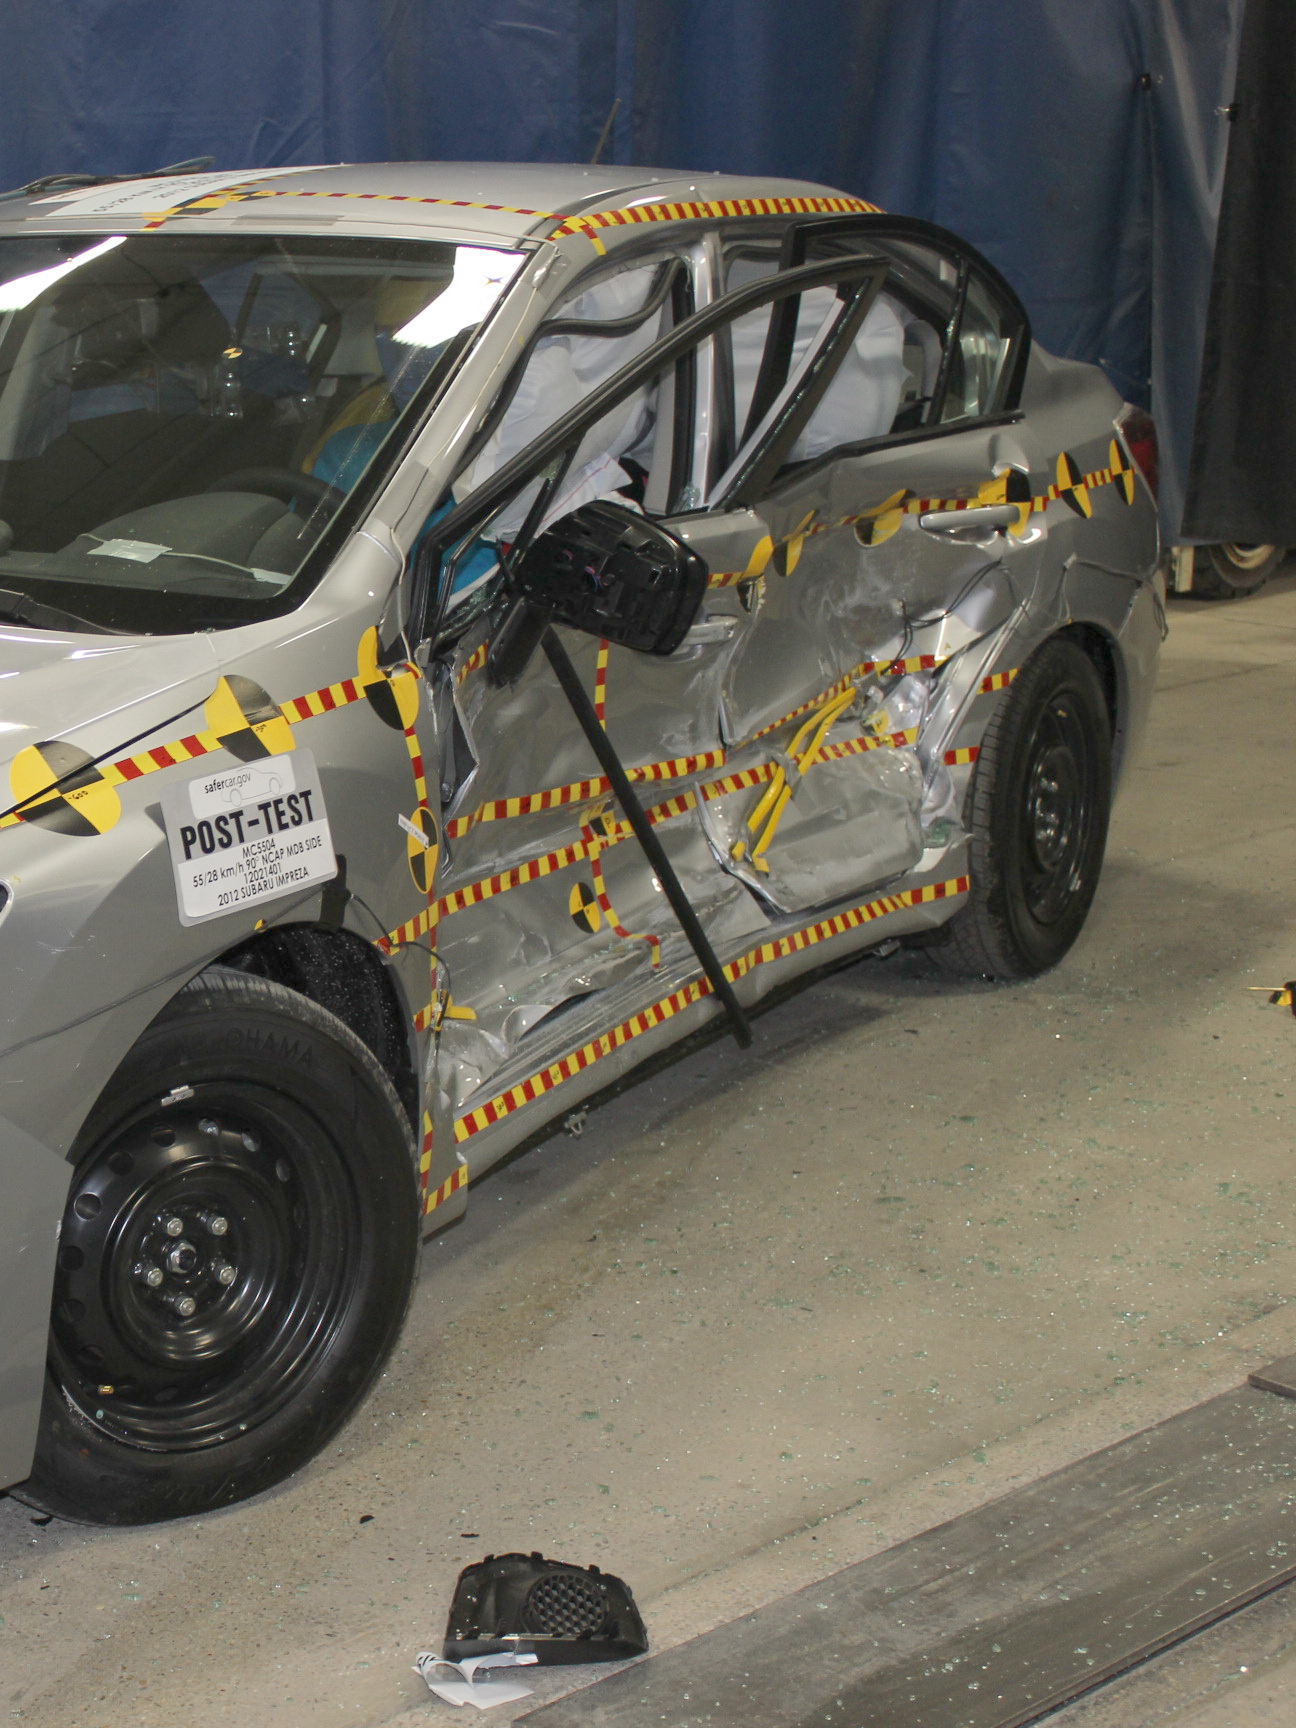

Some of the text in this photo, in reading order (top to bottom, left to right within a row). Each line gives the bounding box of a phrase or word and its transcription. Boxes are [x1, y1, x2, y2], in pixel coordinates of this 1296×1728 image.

[204, 772, 251, 794] safercar.gov
[180, 789, 313, 860] POST-TEST
[192, 835, 323, 888] 55/28 km/h 90° NCAP MDB SIDE
[242, 838, 276, 859] MC5504
[217, 866, 310, 907] 2012 SUBARU IMPREZA
[243, 861, 282, 885] 12021401
